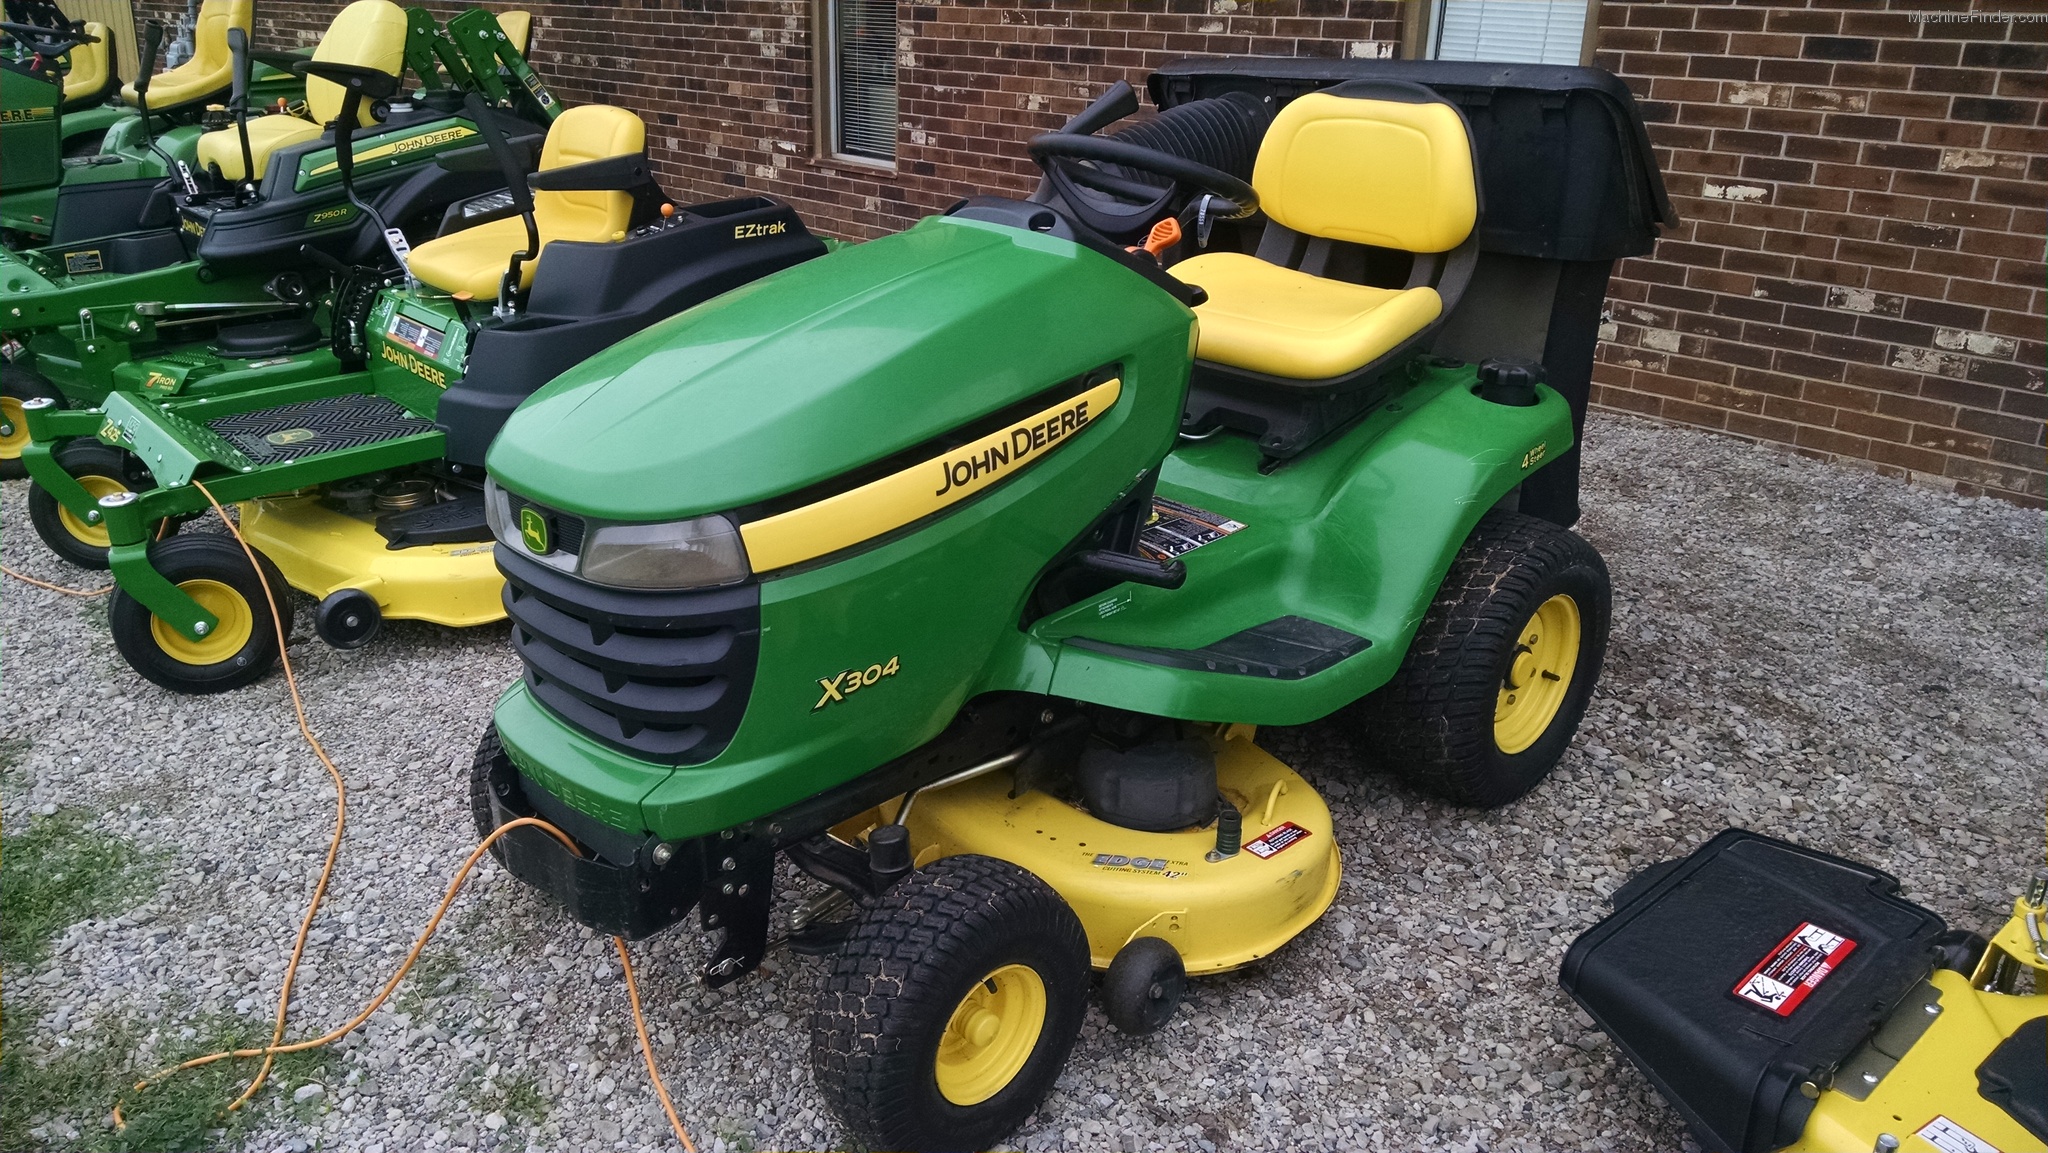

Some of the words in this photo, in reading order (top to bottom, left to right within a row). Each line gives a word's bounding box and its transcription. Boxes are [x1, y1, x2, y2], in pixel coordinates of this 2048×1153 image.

[392, 138, 423, 154] JOHN
[424, 129, 464, 145] DEERE
[734, 220, 787, 239] EZtrak
[382, 340, 409, 370] JOHN
[408, 353, 447, 390] DEERE
[936, 441, 1009, 497] JOHN
[1011, 400, 1089, 461] DEERE
[812, 654, 901, 711] X304
[1091, 853, 1168, 871] EDGE
[1132, 868, 1162, 876] SYSTEM
[1803, 965, 1828, 988] DANGER
